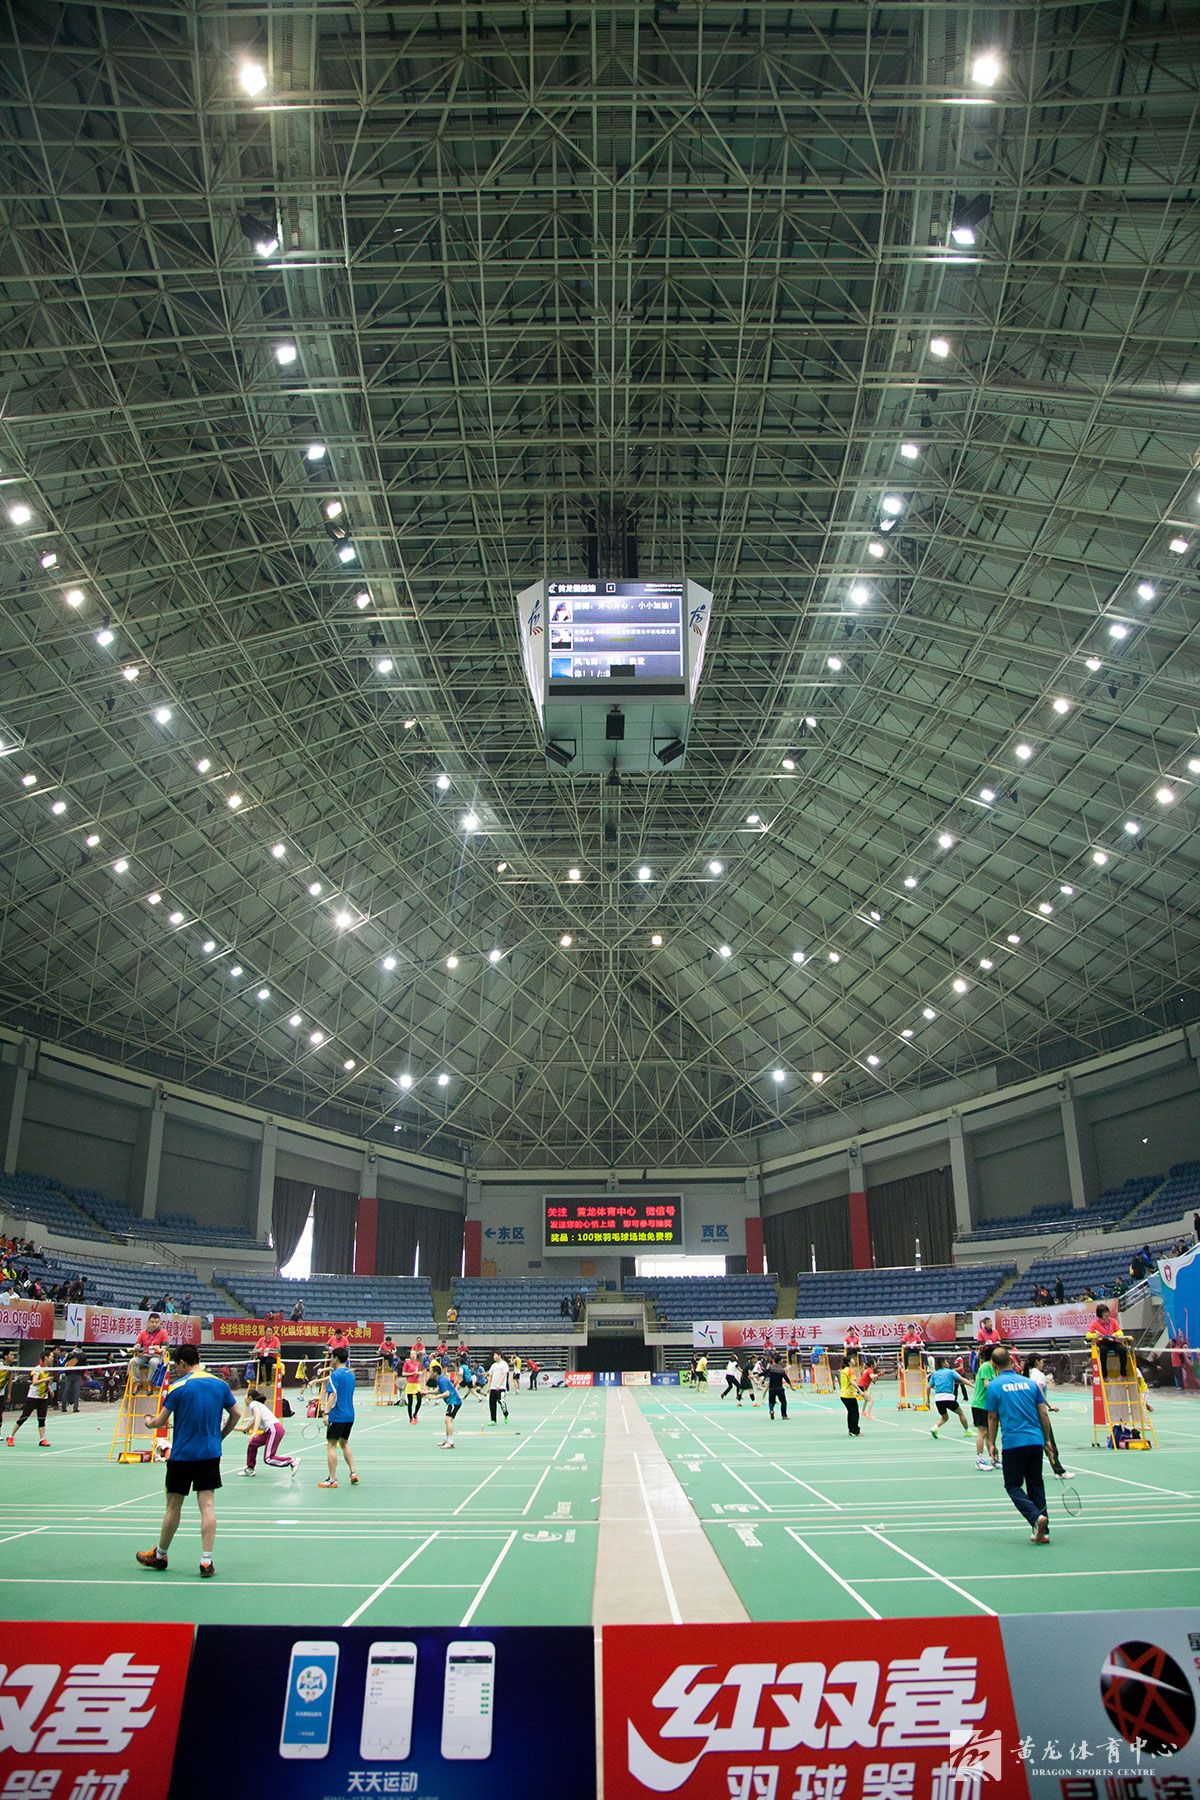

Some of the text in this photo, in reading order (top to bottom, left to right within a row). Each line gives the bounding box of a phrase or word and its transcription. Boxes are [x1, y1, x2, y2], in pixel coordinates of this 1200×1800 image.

[547, 1205, 675, 1217] 关注 黄龙体育中心 微信号
[498, 1225, 525, 1240] 东区
[701, 1224, 729, 1238] 西区
[91, 1314, 142, 1336] 中国体育彩票
[741, 1325, 823, 1341] 体彩手拉手
[1002, 1382, 1030, 1392] CHINA
[652, 1646, 987, 1752] 红双喜
[346, 1771, 419, 1792] 天天运动
